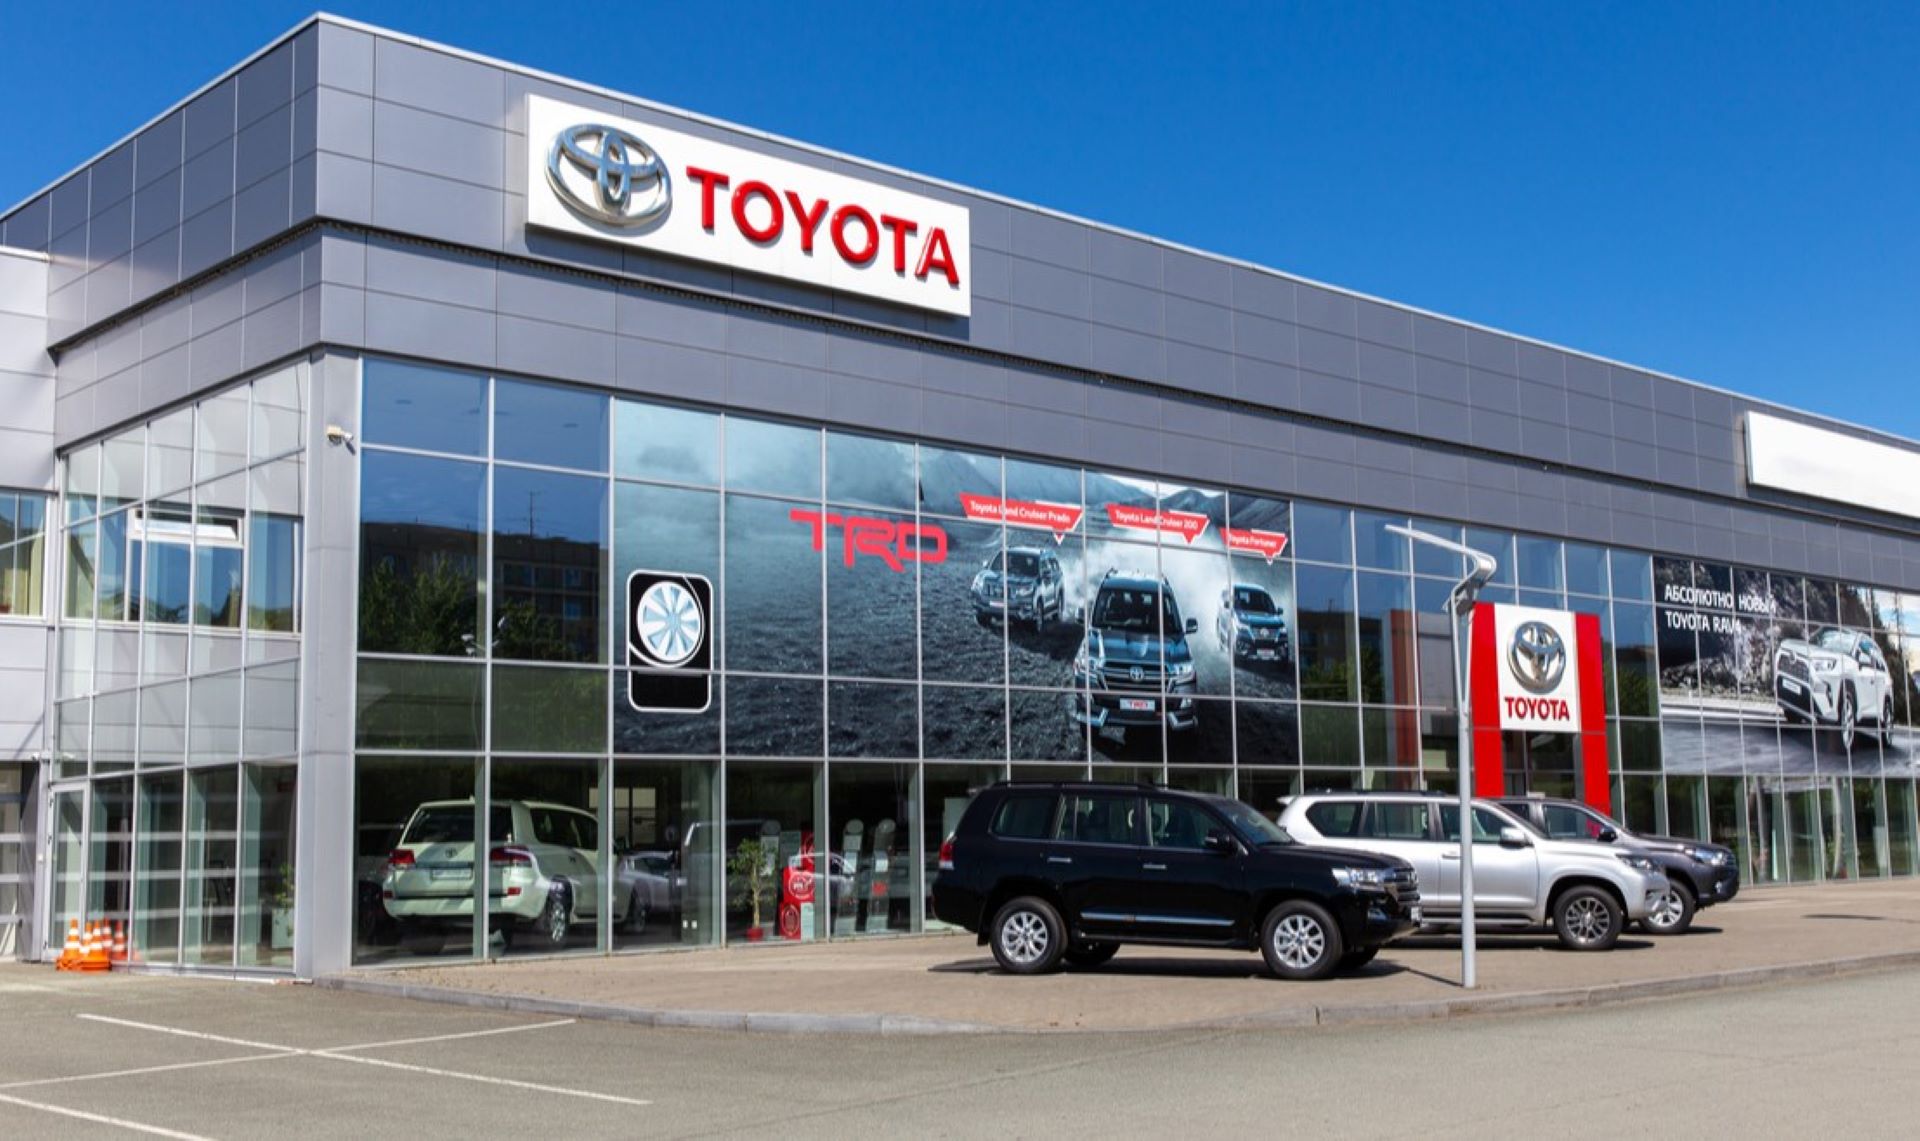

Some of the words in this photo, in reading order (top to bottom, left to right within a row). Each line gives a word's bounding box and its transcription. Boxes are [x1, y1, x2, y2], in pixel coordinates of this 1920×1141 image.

[686, 166, 959, 285] TOYOTA
[970, 500, 997, 515] Toyota
[1115, 510, 1140, 523] Toyota
[790, 508, 947, 572] TRD
[1664, 584, 1733, 608] АБСОЛЮТНО
[1738, 594, 1777, 613] НОВЫЙ
[1665, 611, 1710, 632] TOYOTA
[1504, 697, 1570, 722] TOYOTA
